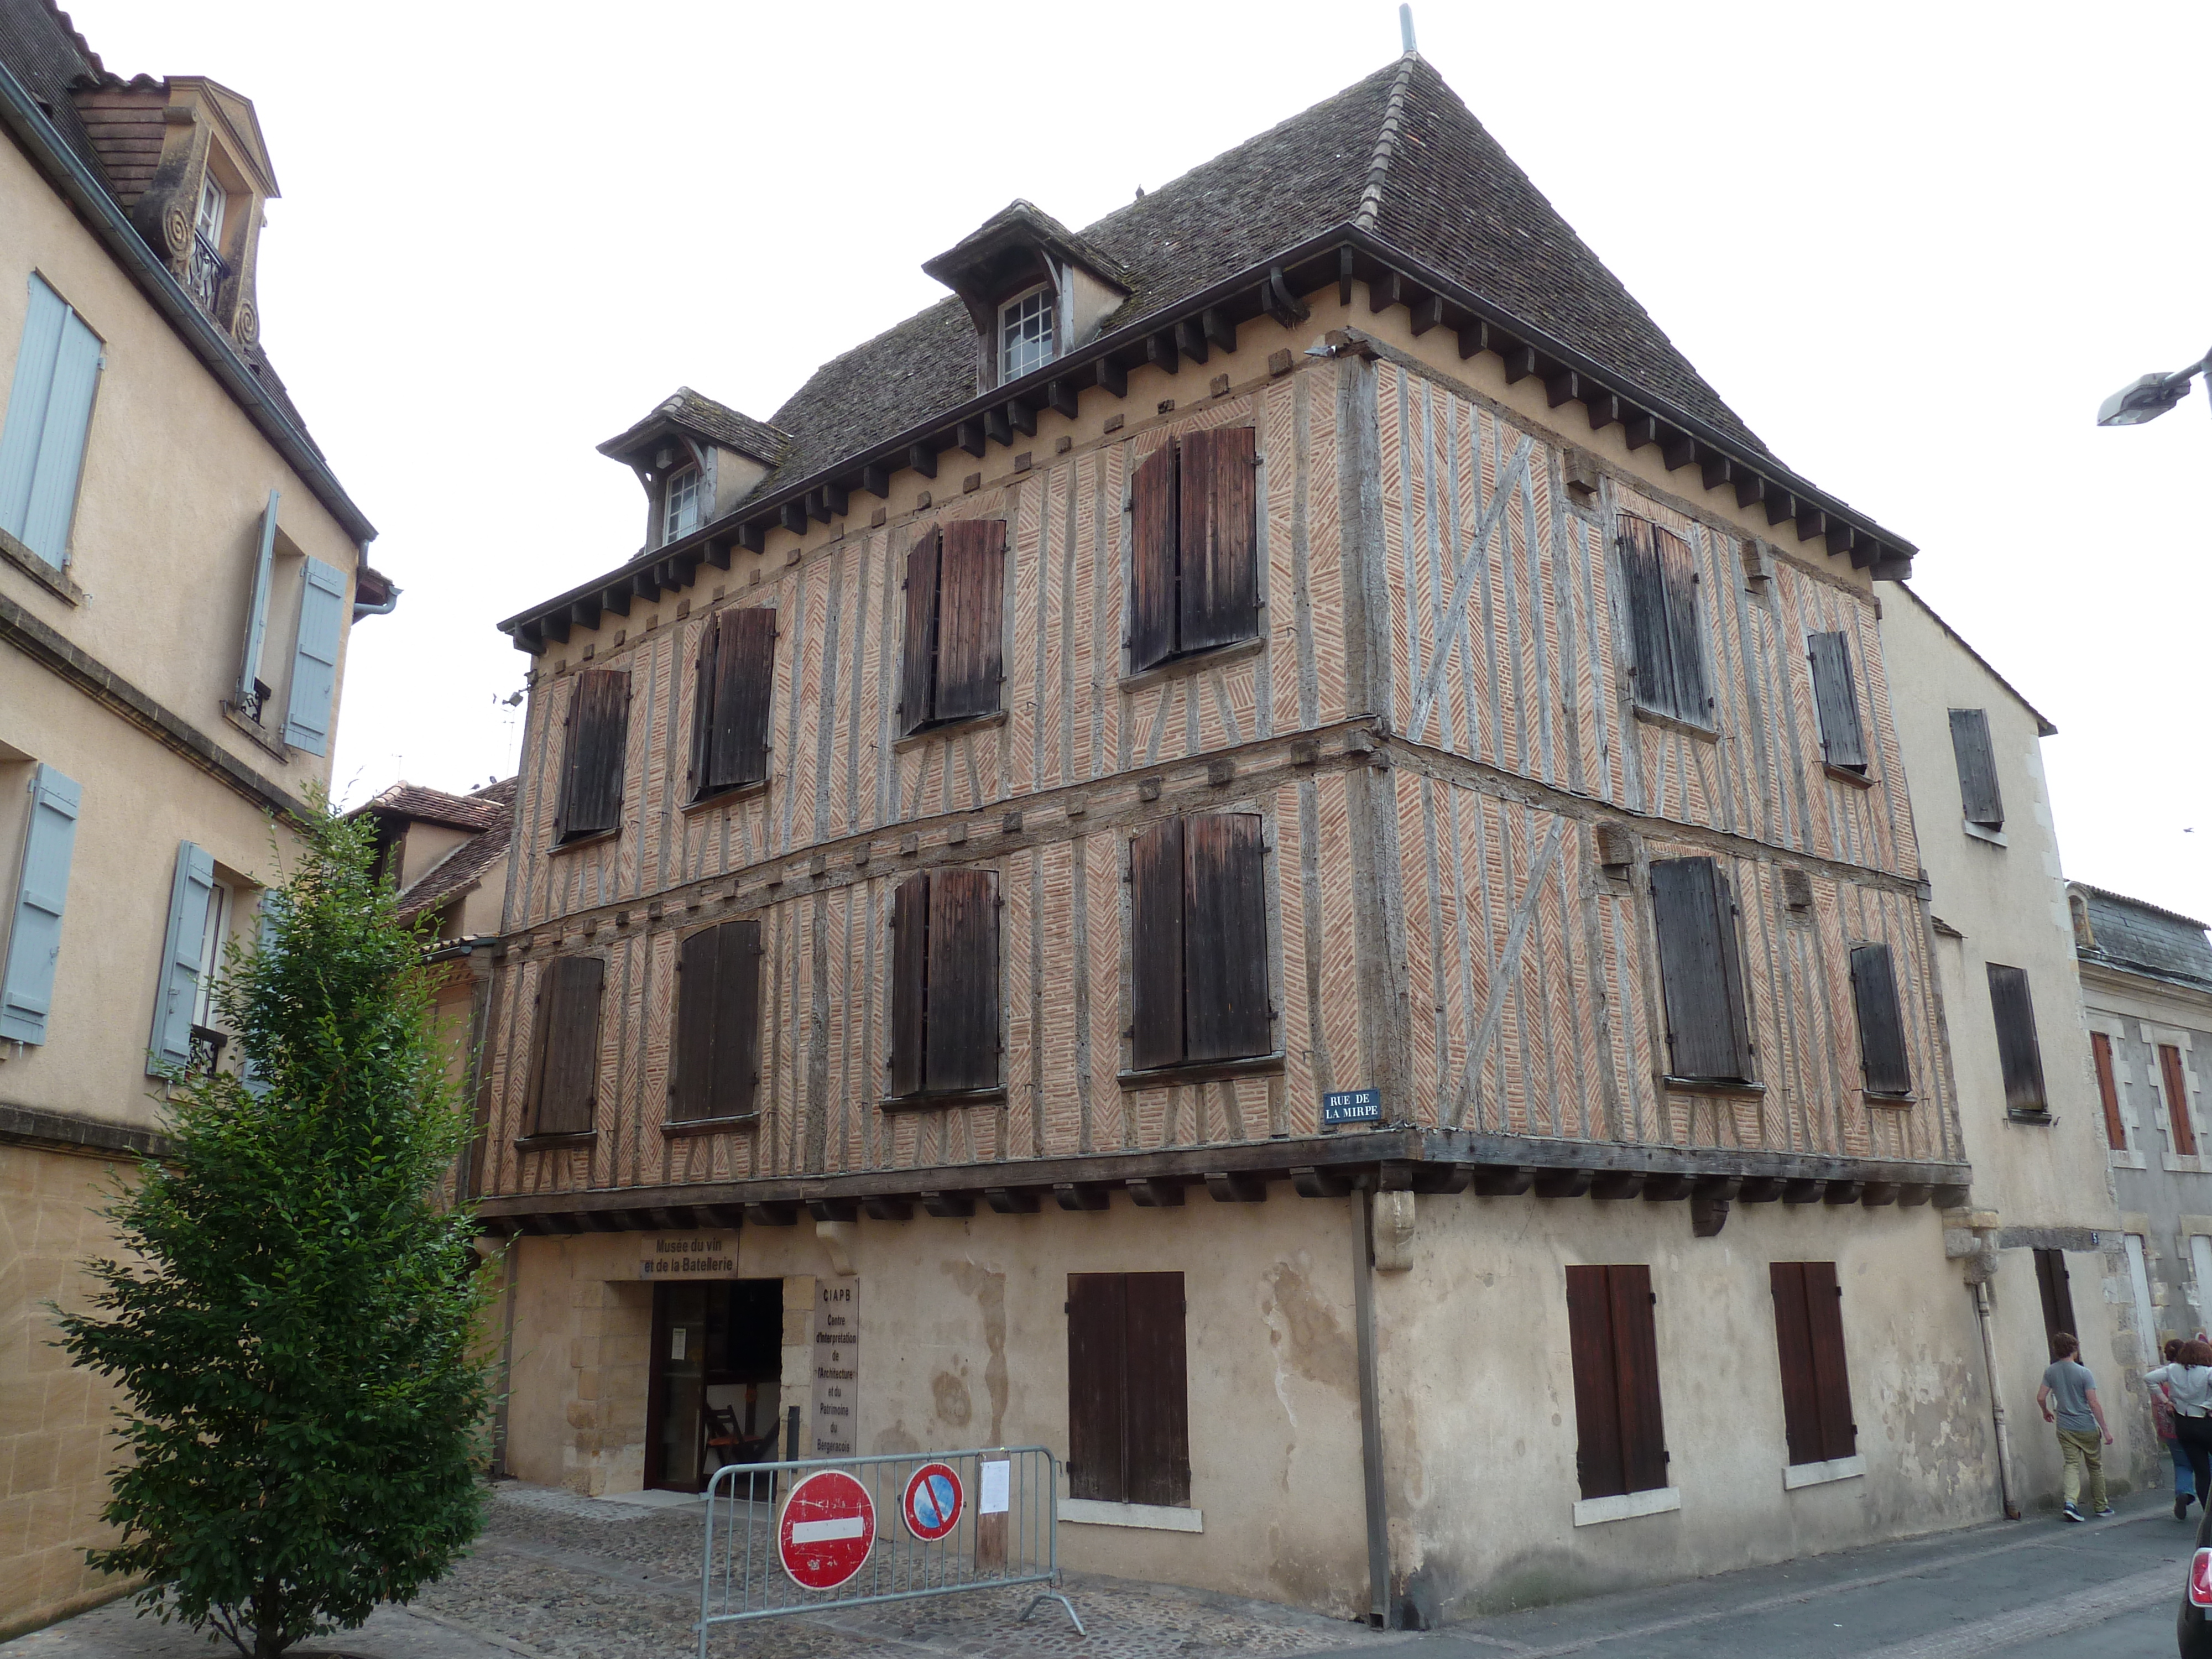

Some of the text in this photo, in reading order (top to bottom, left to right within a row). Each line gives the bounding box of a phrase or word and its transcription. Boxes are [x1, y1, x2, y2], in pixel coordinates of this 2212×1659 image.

[1330, 1094, 1369, 1106] RUE DE
[1326, 1105, 1378, 1119] LA MIRPE
[2093, 1233, 2098, 1243] 5
[656, 1237, 722, 1253] Musée du vin
[644, 1256, 733, 1272] et de la Batellerie
[827, 1314, 845, 1326] Centre
[832, 1349, 839, 1361] de
[817, 1366, 853, 1379] l'Architecture
[828, 1385, 841, 1397] et du
[820, 1402, 848, 1416] Patrimoine
[830, 1421, 837, 1433] du
[817, 1438, 849, 1454] Bergeracois
